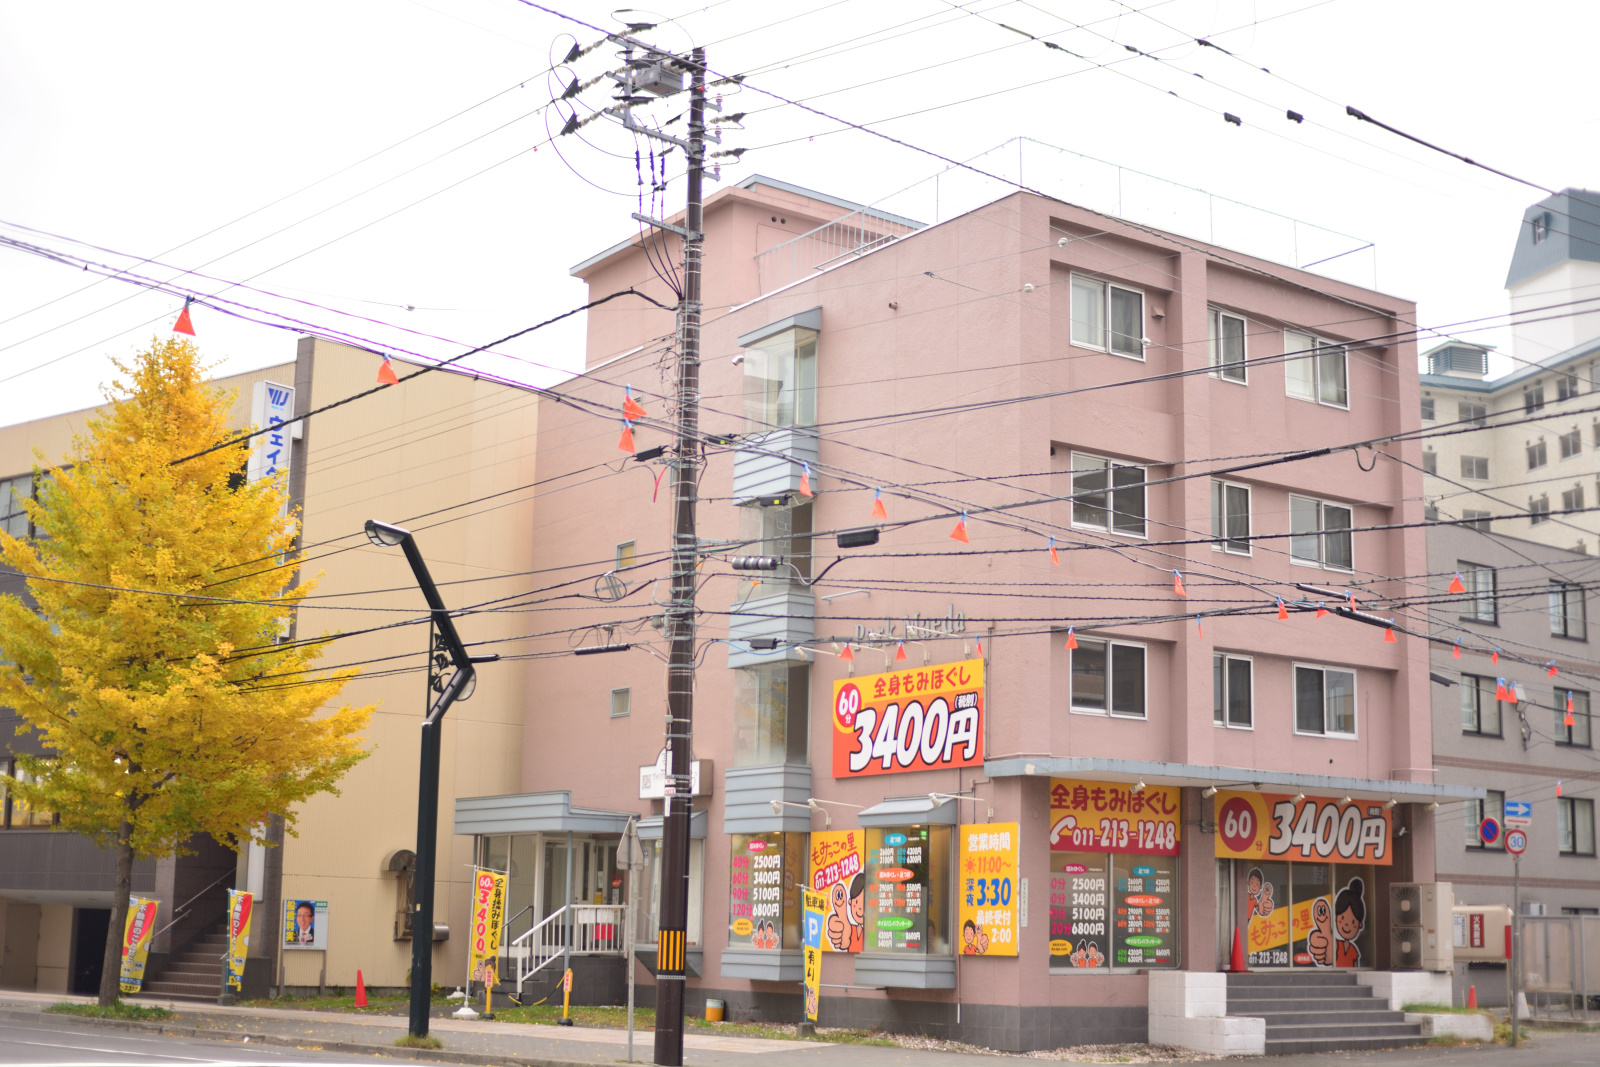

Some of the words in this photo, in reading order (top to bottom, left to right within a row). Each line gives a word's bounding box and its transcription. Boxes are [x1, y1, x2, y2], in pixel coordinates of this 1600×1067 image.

[874, 666, 971, 698] 全身もみほぐし
[849, 697, 979, 772] 3400円
[1050, 784, 1177, 815] 全身もみほぐし
[1072, 818, 1176, 850] 011-213-1248
[1269, 801, 1387, 859] 3400円
[812, 832, 857, 866] もみっこの里
[968, 832, 1011, 852] 営業時間
[1510, 836, 1524, 848] 30
[733, 855, 749, 869] 40分
[753, 855, 780, 869] 2500円
[733, 871, 749, 885] 60分
[753, 871, 780, 885] 3400円
[815, 853, 860, 889] 011-213-1248
[977, 877, 1012, 906] 3:30
[1050, 878, 1066, 891] 0分
[1072, 878, 1105, 891] 2500円
[733, 887, 749, 901] 90分
[753, 887, 780, 901] 5100円
[966, 878, 975, 907] 深夜
[1050, 893, 1066, 906] 0分
[1072, 893, 1105, 906] 3400円
[733, 903, 753, 917] 120分
[753, 903, 780, 917] 6800円
[976, 910, 1011, 925] 最終受付
[1050, 908, 1066, 921] 0分
[1072, 908, 1105, 921] 5100円
[1050, 922, 1072, 935] 20分
[1072, 922, 1105, 935] 6800円
[1251, 909, 1314, 946] もみっこの里
[992, 928, 1012, 943] 2:00
[1249, 952, 1288, 964] 011-213-1248
